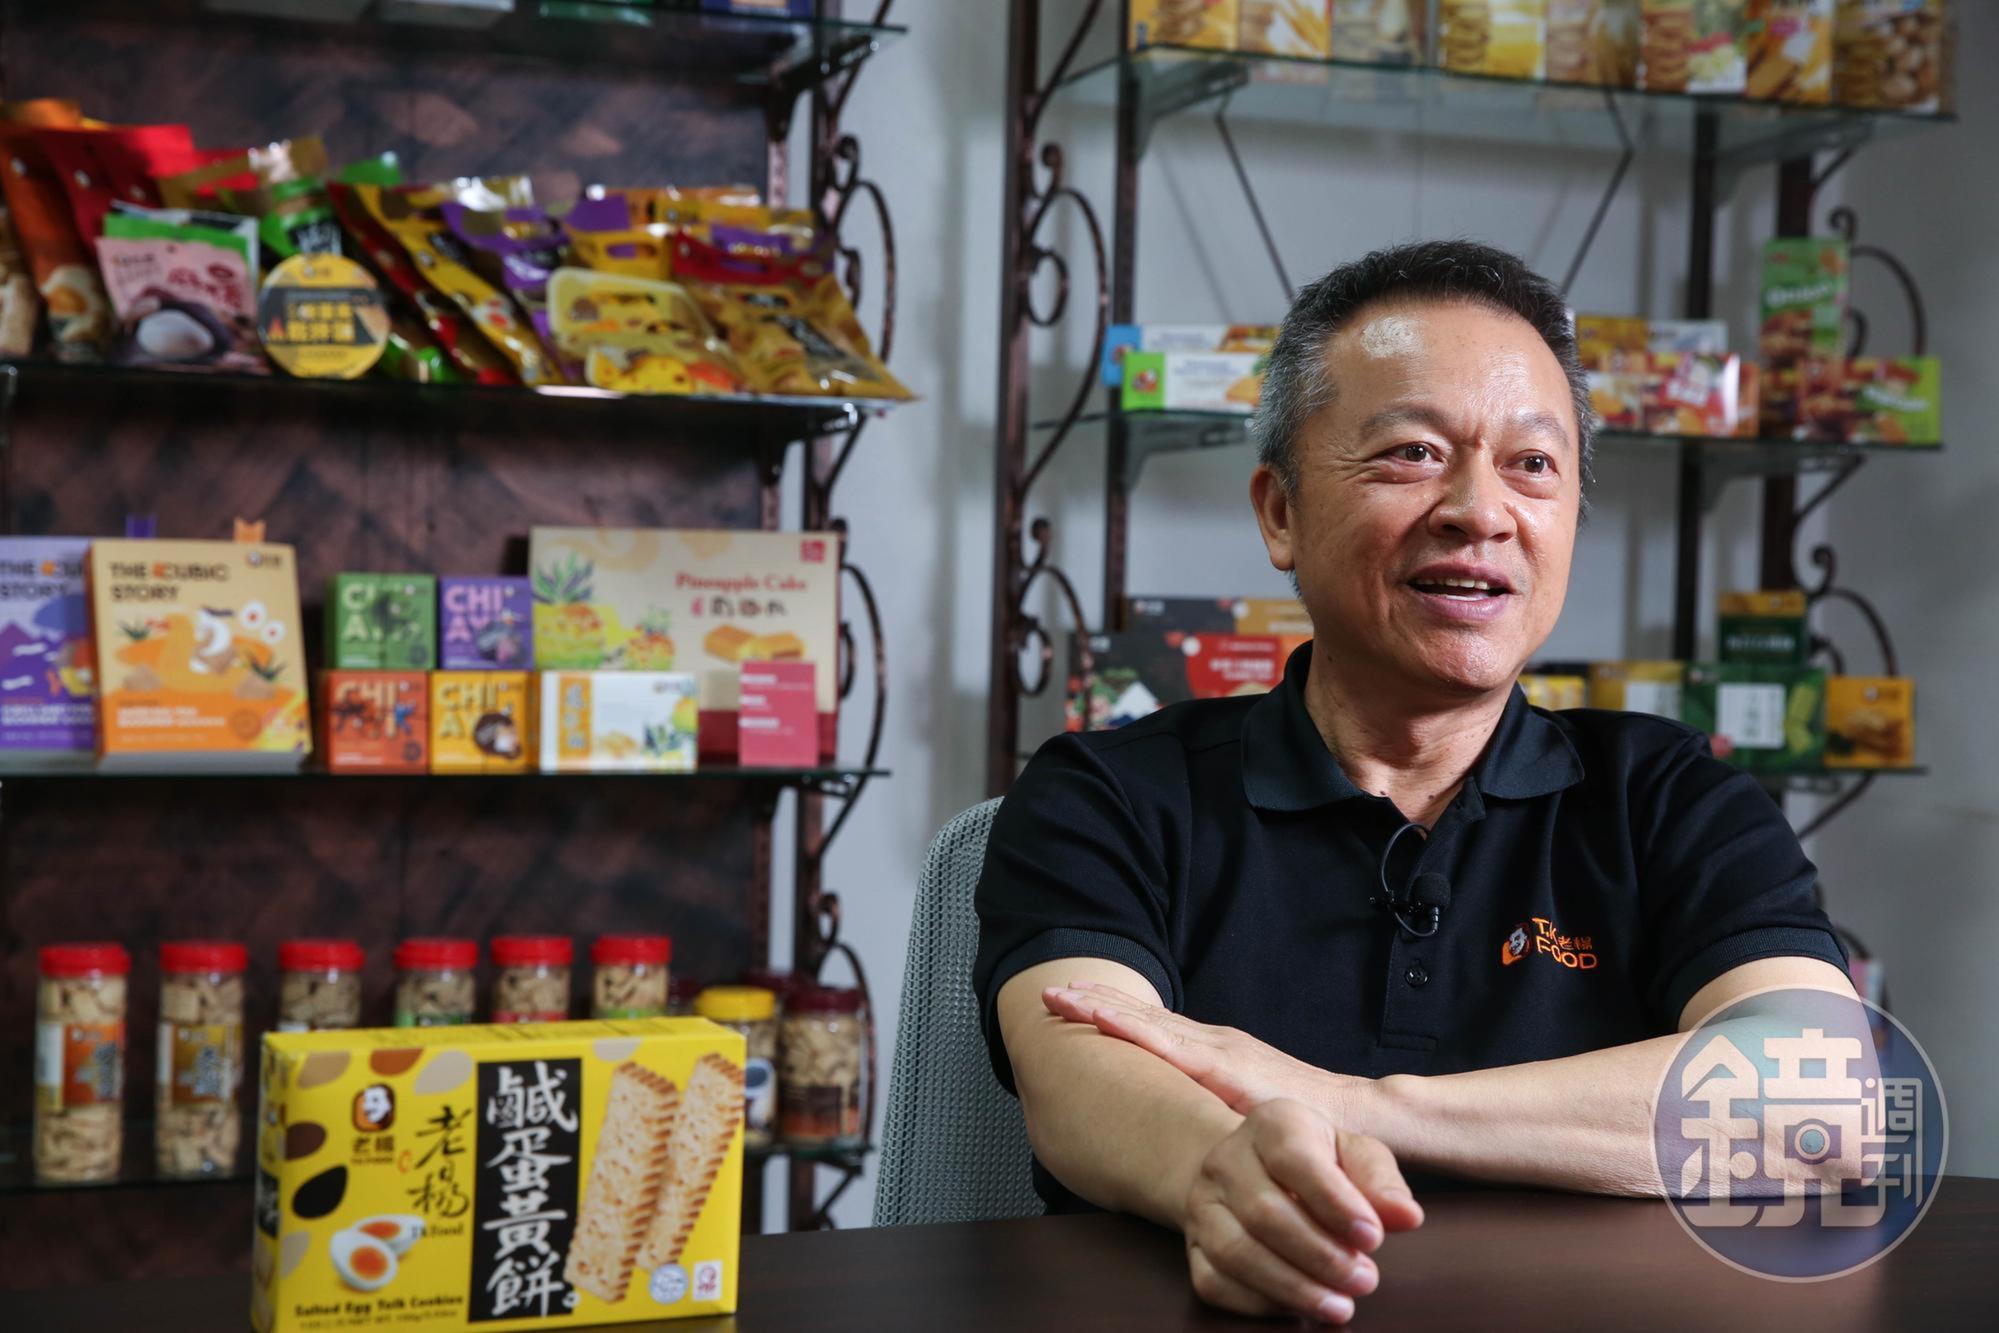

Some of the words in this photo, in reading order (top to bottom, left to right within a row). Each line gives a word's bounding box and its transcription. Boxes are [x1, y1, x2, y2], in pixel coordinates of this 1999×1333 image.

[110, 563, 148, 579] THE
[675, 571, 759, 591] Pineapple
[763, 574, 808, 591] Cake
[111, 584, 180, 601] STORY
[1536, 935, 1597, 969] FOOD
[294, 1303, 339, 1317] Salted
[345, 1302, 372, 1315] Egg
[411, 1295, 464, 1308] Cookies
